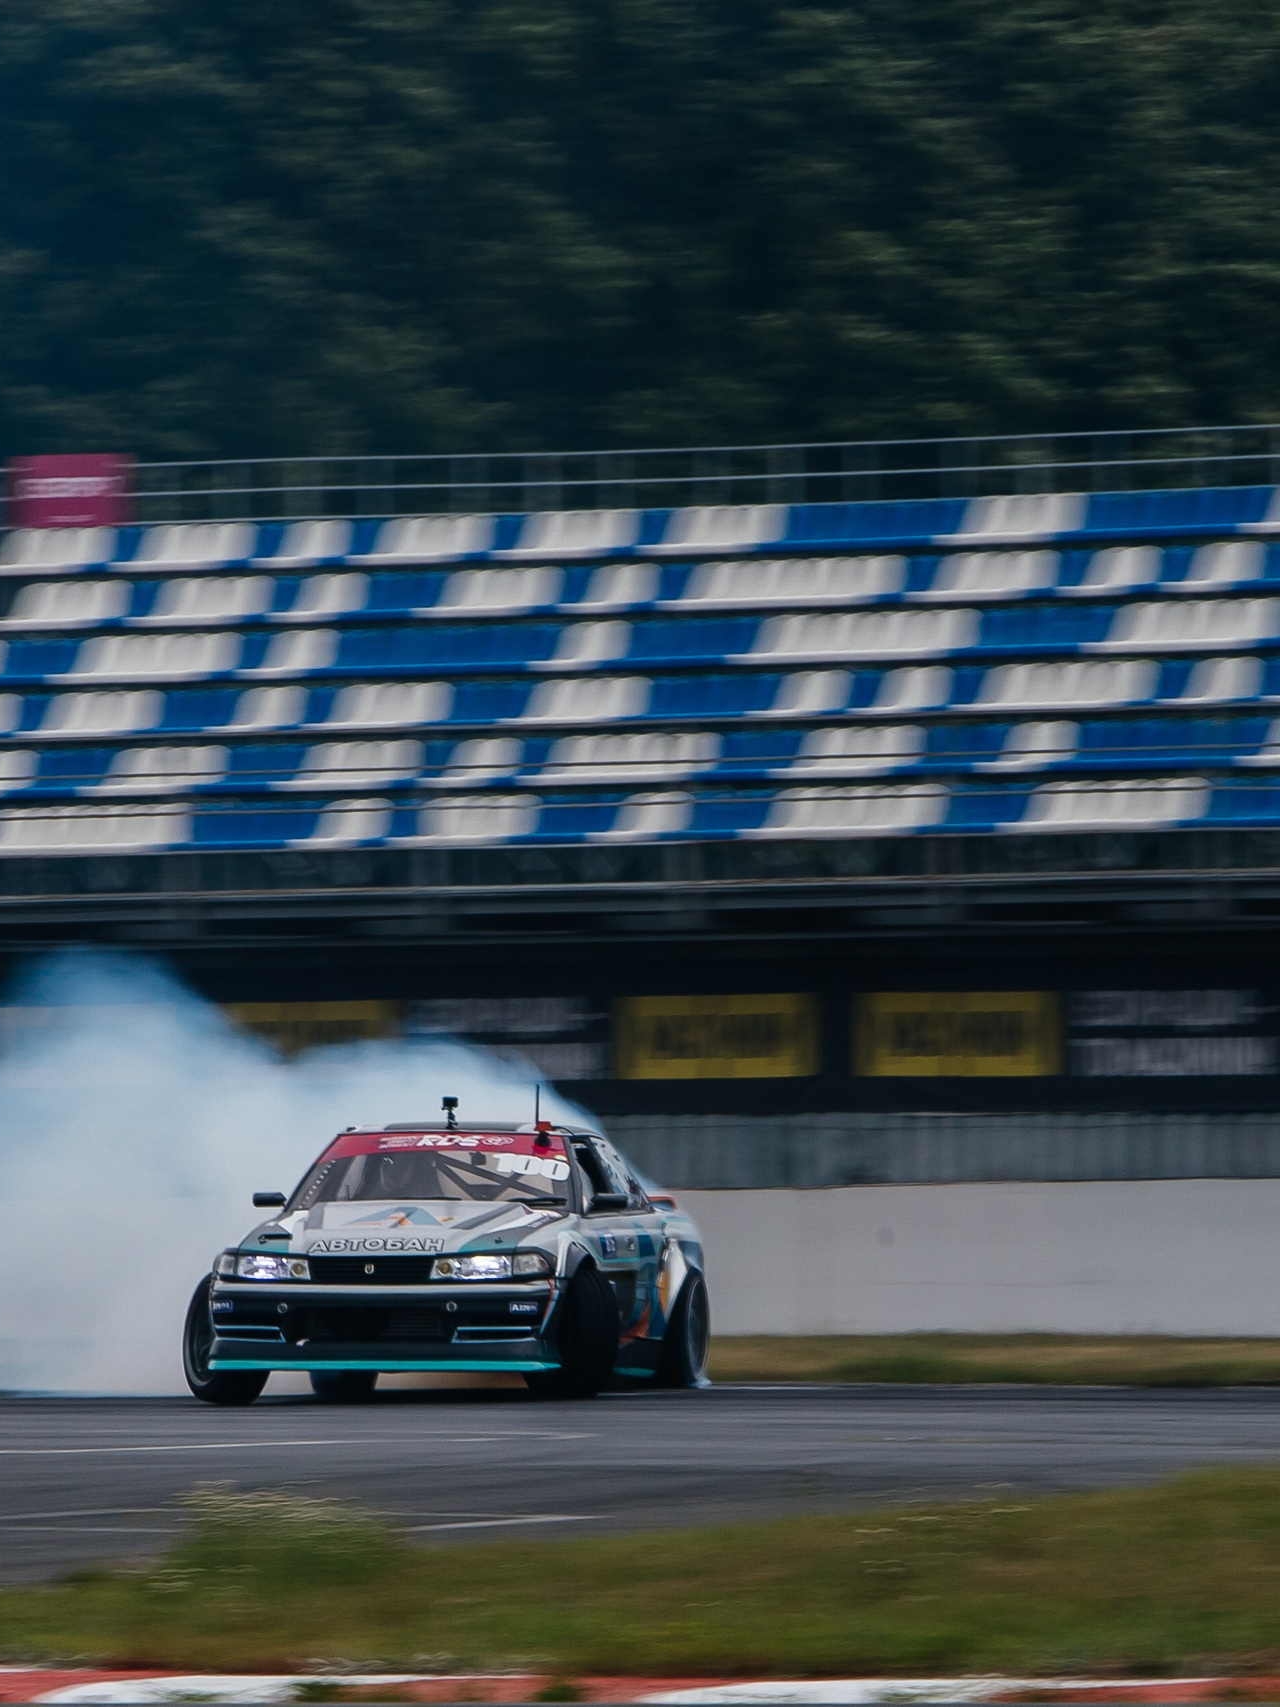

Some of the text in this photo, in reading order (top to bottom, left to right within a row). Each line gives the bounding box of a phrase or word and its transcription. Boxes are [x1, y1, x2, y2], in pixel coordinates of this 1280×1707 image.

[416, 1135, 484, 1147] RDS
[493, 1153, 570, 1181] 100
[308, 1237, 445, 1253] АВТОБАН
